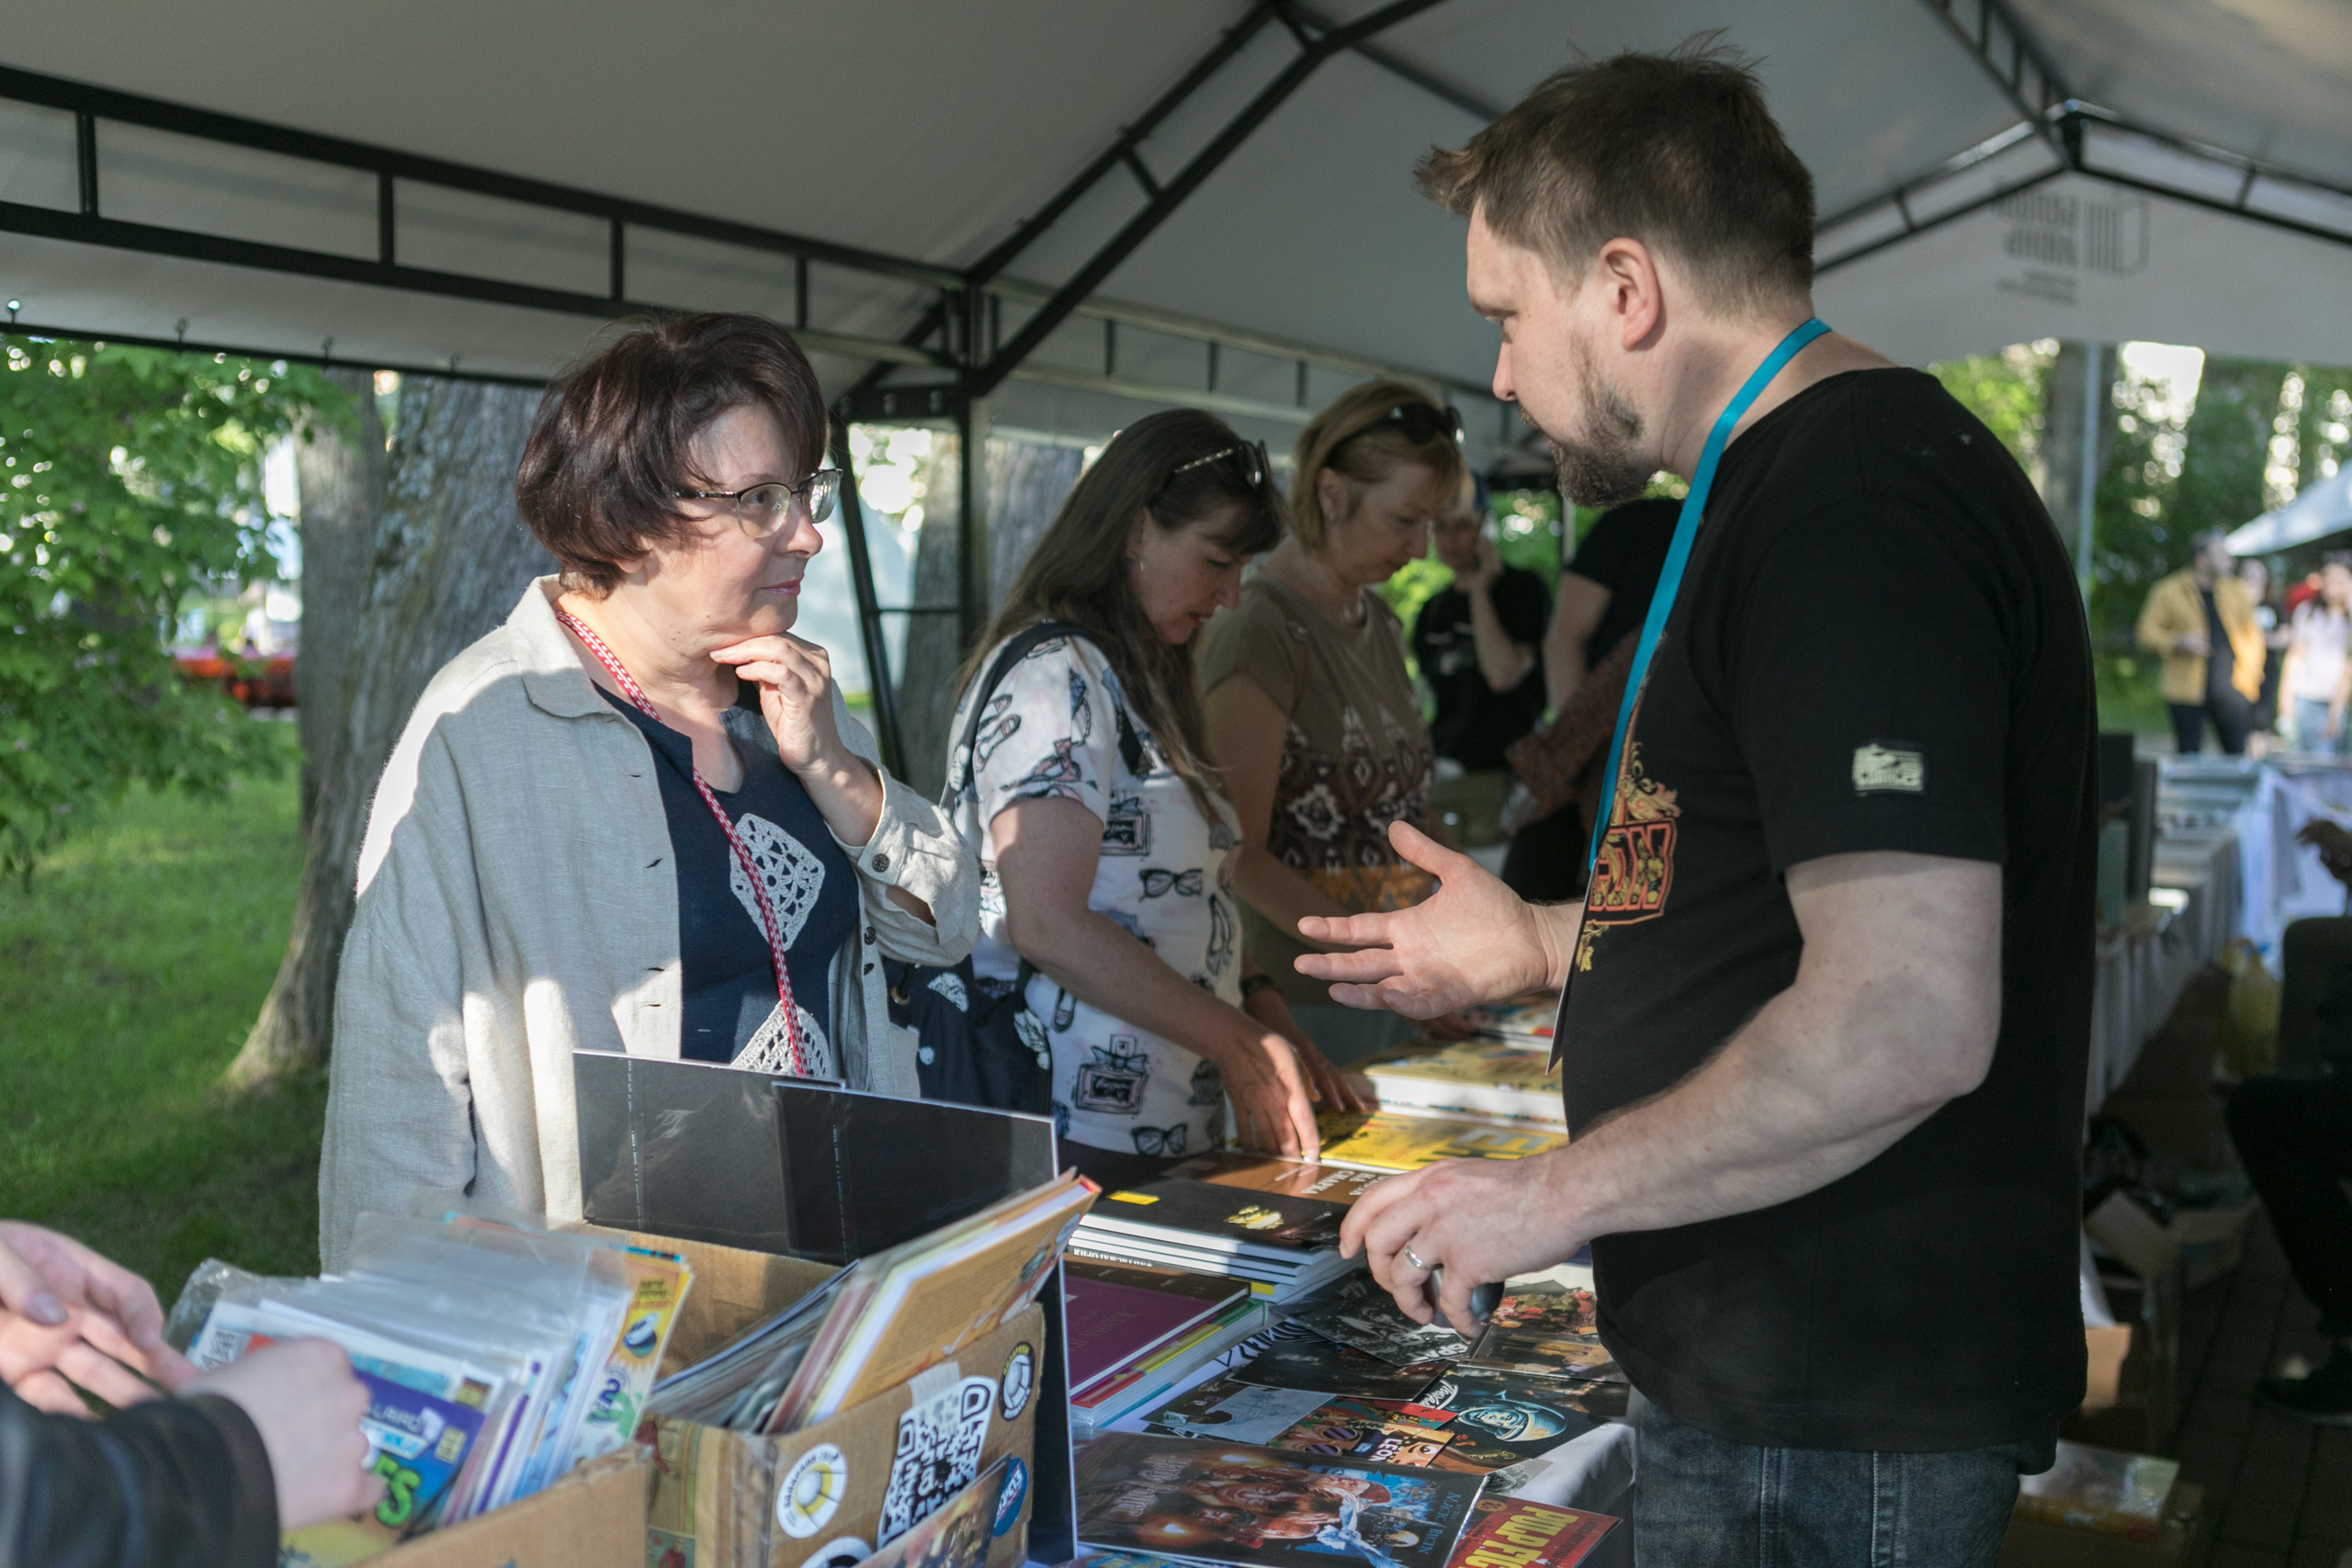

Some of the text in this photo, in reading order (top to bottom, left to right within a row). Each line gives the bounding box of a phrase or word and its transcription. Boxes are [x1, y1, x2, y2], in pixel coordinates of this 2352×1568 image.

[1300, 1169, 1355, 1195] СНАРКА
[1417, 1492, 1461, 1554] MAGIC BEGIN
[1494, 1505, 1580, 1548] PULP
